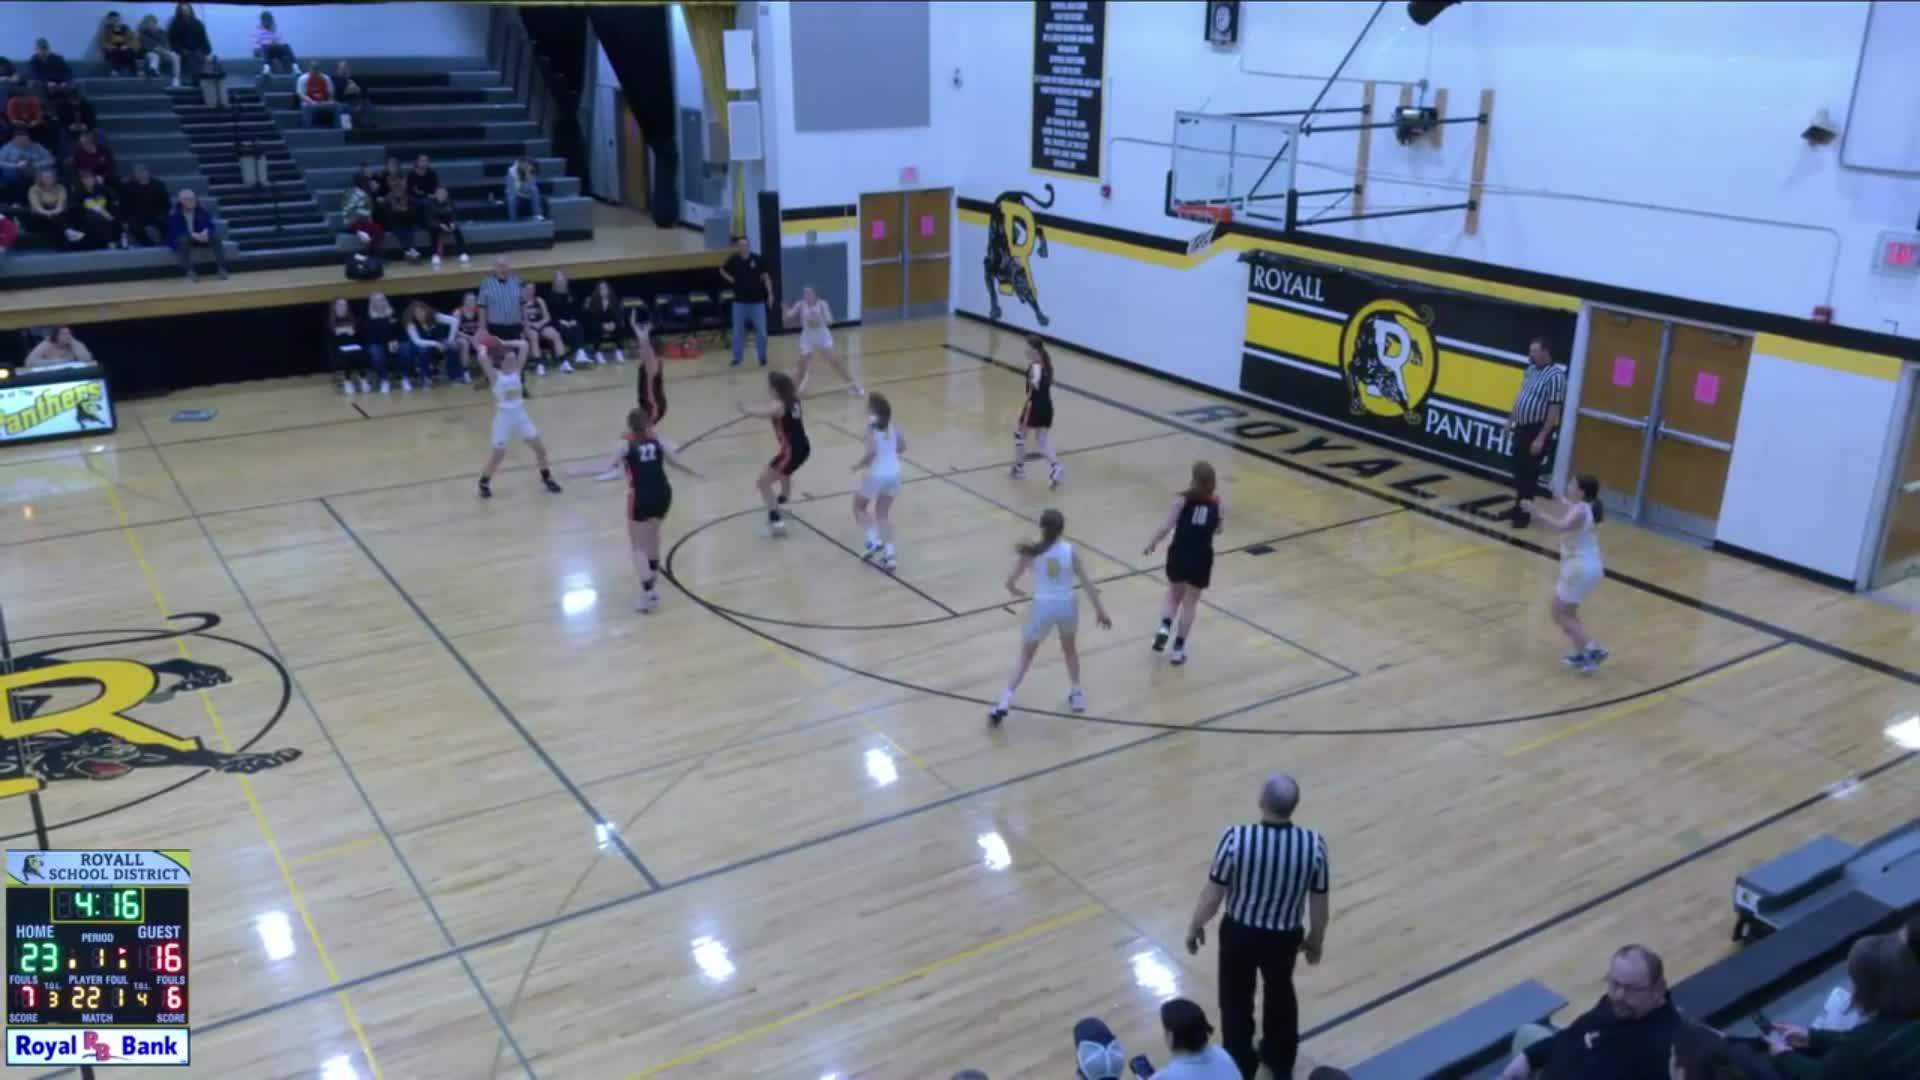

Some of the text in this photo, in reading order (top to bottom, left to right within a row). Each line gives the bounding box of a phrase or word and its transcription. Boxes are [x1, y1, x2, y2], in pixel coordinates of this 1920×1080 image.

[1253, 264, 1326, 303] ROYALL
[0, 383, 101, 434] anthers
[1425, 408, 1515, 457] PANTHE
